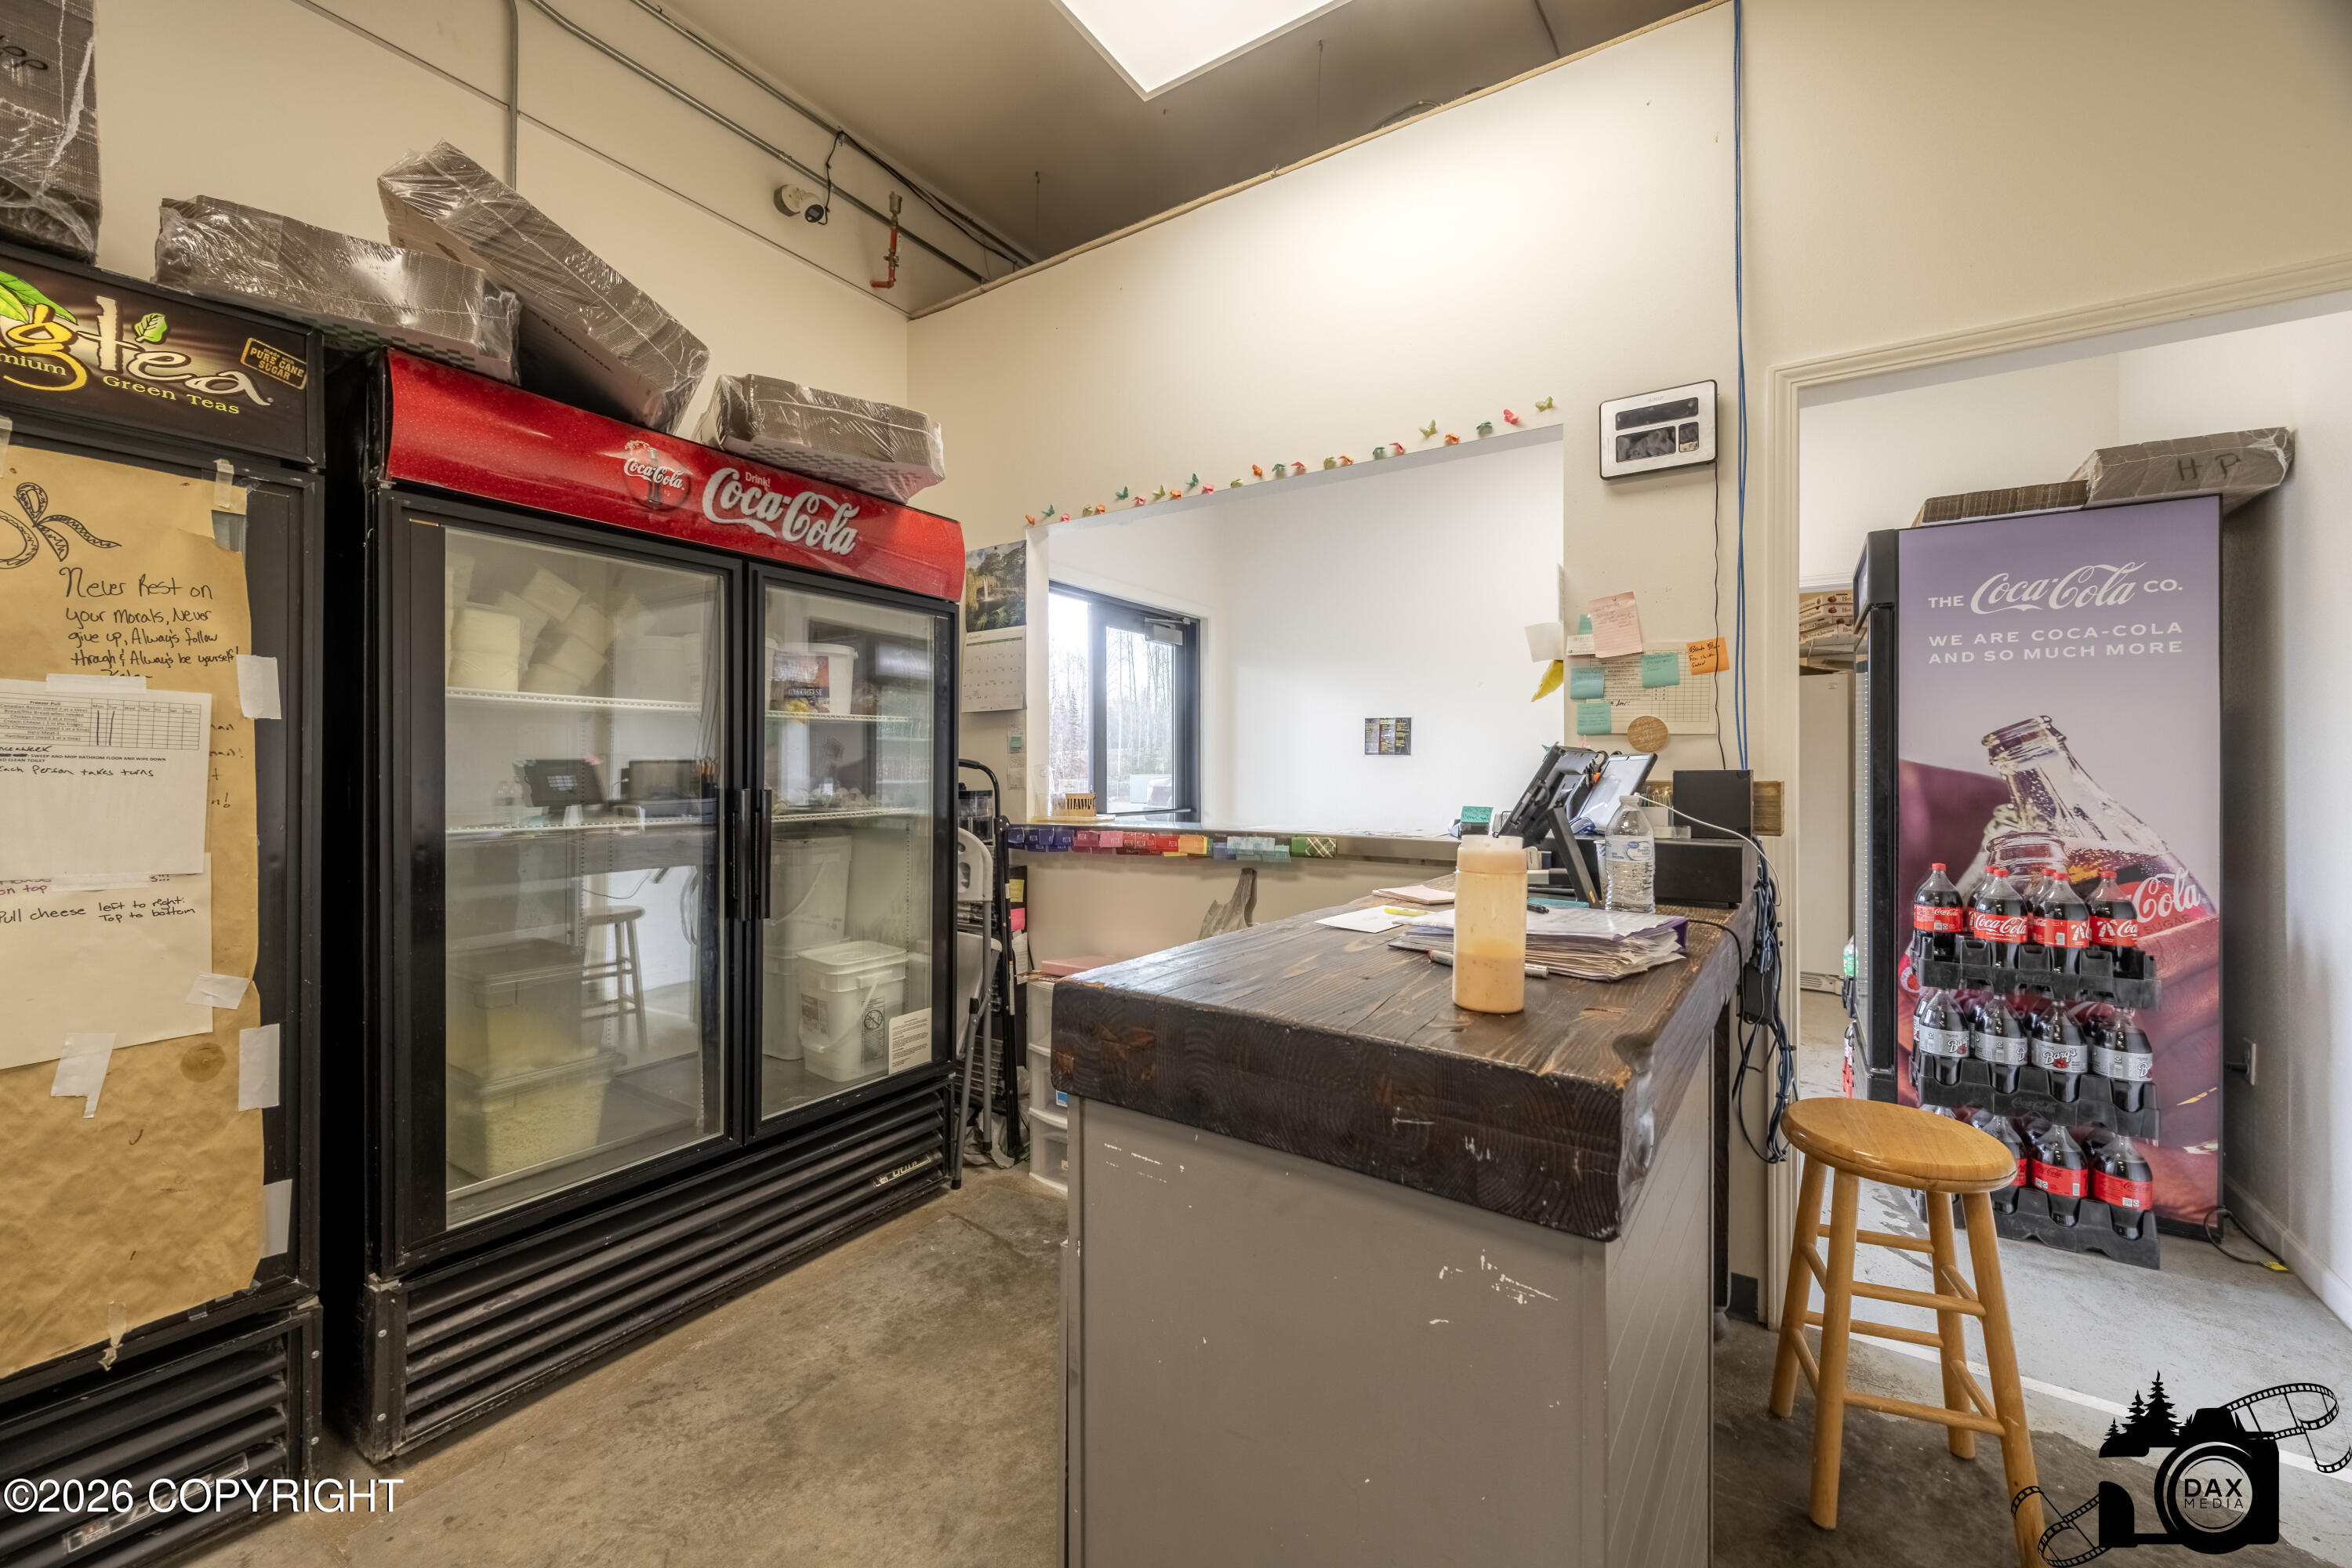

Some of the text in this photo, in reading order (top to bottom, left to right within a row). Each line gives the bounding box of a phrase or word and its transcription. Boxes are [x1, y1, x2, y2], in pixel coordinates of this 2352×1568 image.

[250, 347, 304, 377] PURE CANE
[257, 360, 291, 381] SUGAR
[103, 375, 239, 415] Green Teas
[624, 458, 684, 488] Coca-Cola
[745, 470, 771, 488] Drink!
[702, 467, 859, 555] Coca-Cola
[59, 567, 126, 597] Never
[190, 585, 213, 600] on
[1929, 561, 2183, 615] THE Coca-Cola CO.
[66, 608, 106, 629] your
[172, 608, 212, 622] Never
[68, 631, 100, 648] give
[185, 627, 218, 646] follow
[1929, 622, 2183, 647] WE ARE COCA-COLA
[178, 653, 191, 664] be
[1929, 641, 2183, 664] AND SO MUCH MORE
[32, 765, 74, 775] Person
[81, 768, 114, 776] takes
[121, 768, 154, 777] turns
[23, 885, 48, 895] top
[0, 908, 86, 924] Pull cheese
[98, 902, 125, 912] left
[98, 914, 122, 924] Top
[152, 908, 195, 916] bottom
[1976, 914, 2027, 935] Coca-Cola
[2042, 1047, 2077, 1065] Barq's
